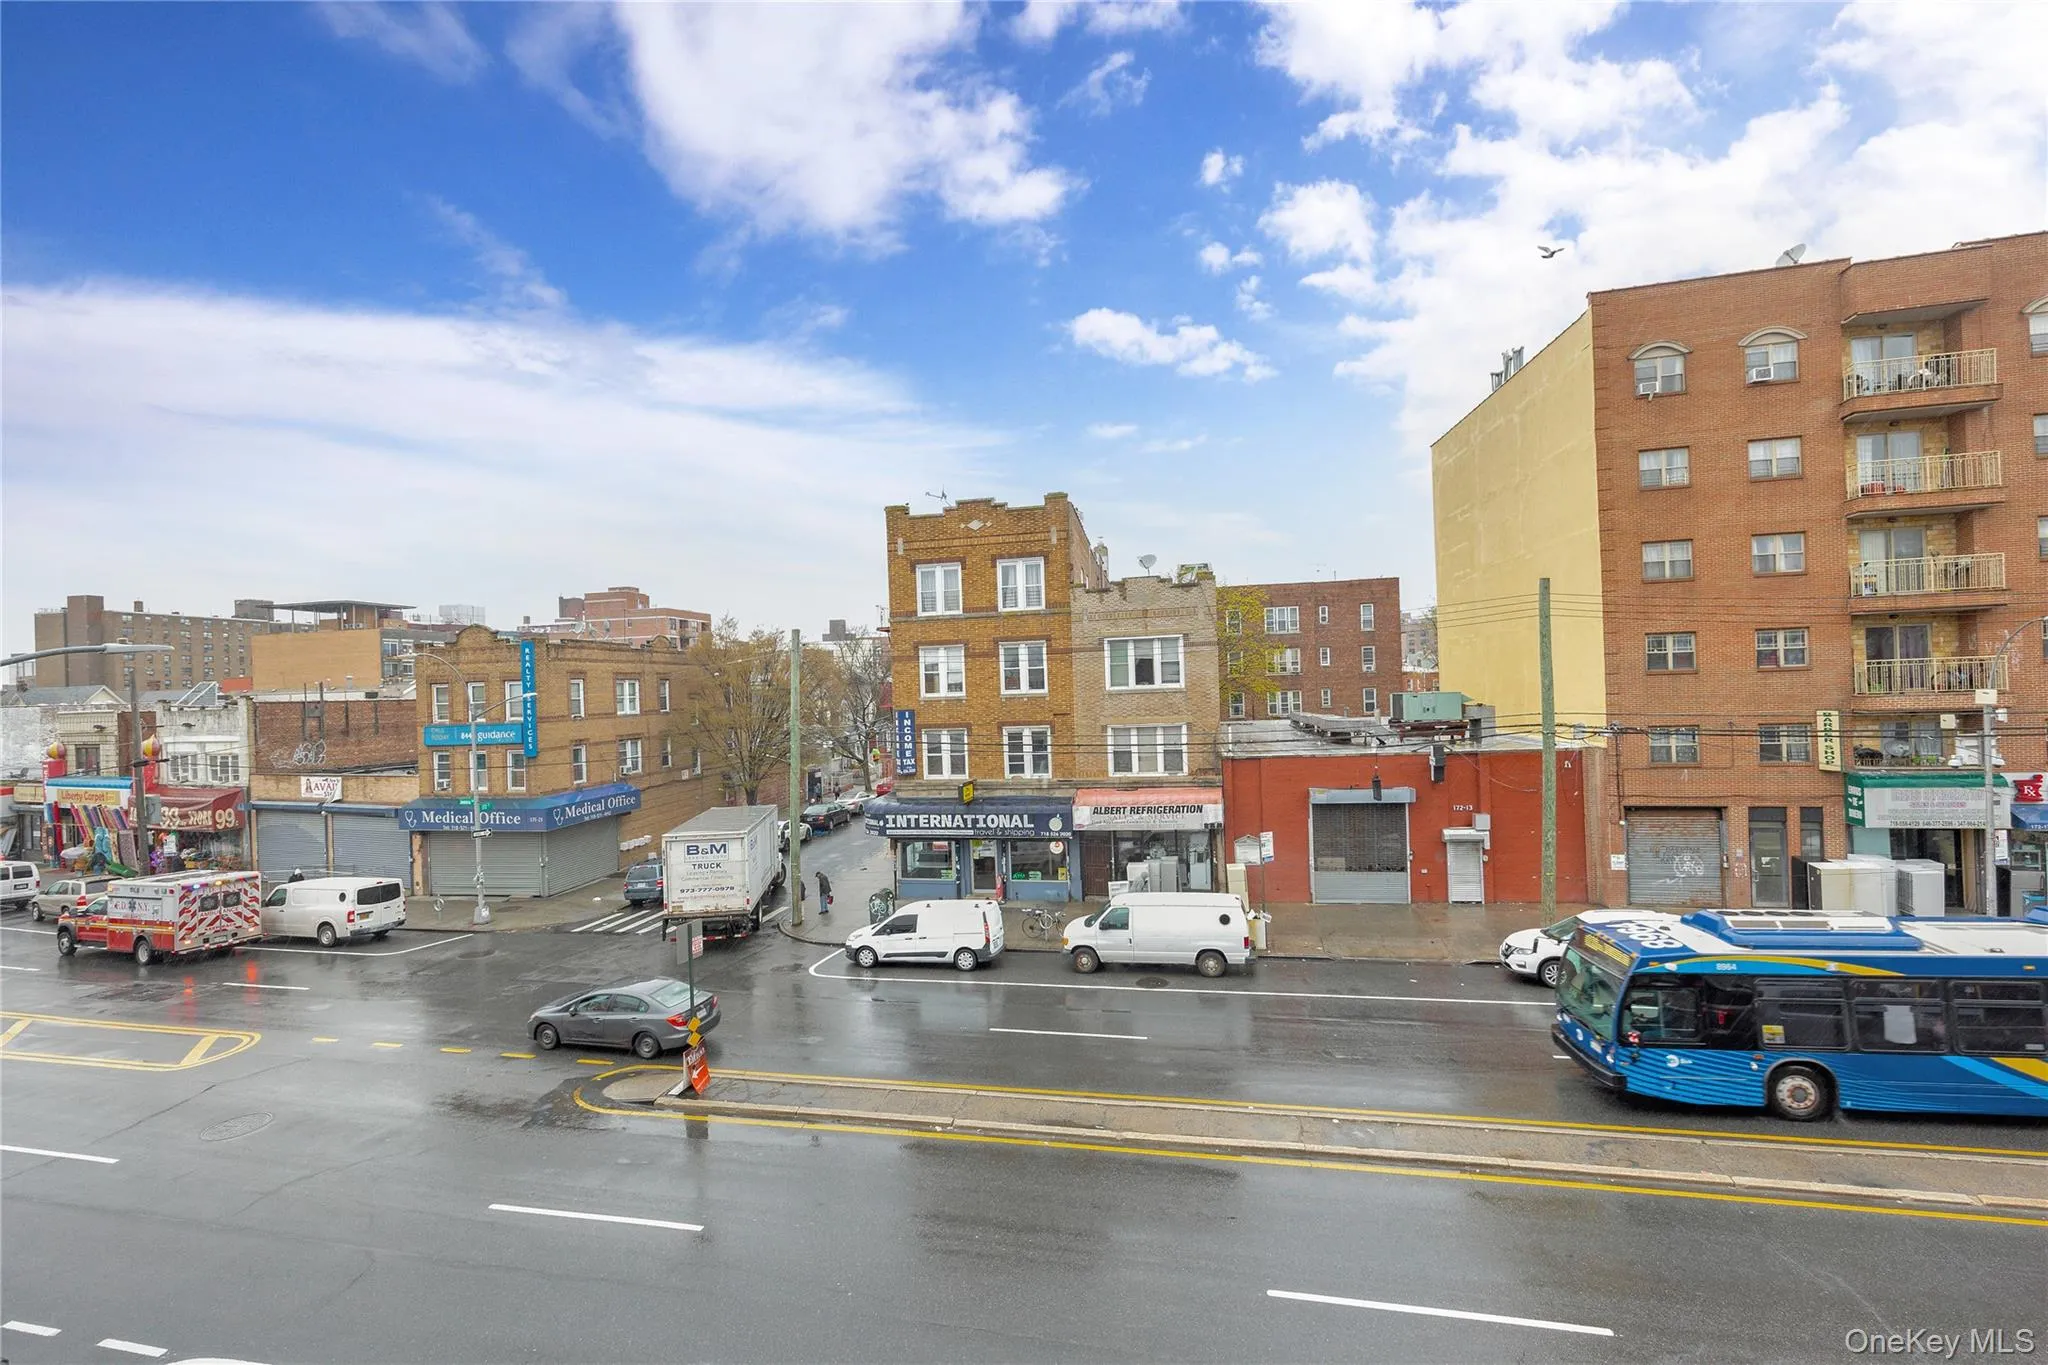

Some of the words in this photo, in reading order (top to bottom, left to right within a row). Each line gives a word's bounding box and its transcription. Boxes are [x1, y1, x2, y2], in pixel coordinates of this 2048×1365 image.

[477, 730, 516, 742] guidance
[903, 711, 912, 758] INCOME
[902, 758, 916, 766] TAX
[564, 800, 605, 819] Medical
[607, 795, 636, 809] Office
[1093, 806, 1127, 815] ALBERT
[1129, 805, 1203, 815] REFRIGERATION
[421, 810, 474, 824] Medical
[479, 811, 521, 824] Office
[885, 814, 1035, 828] INTERNATIONAL
[1004, 828, 1035, 837] shipping
[686, 844, 727, 855] B&M
